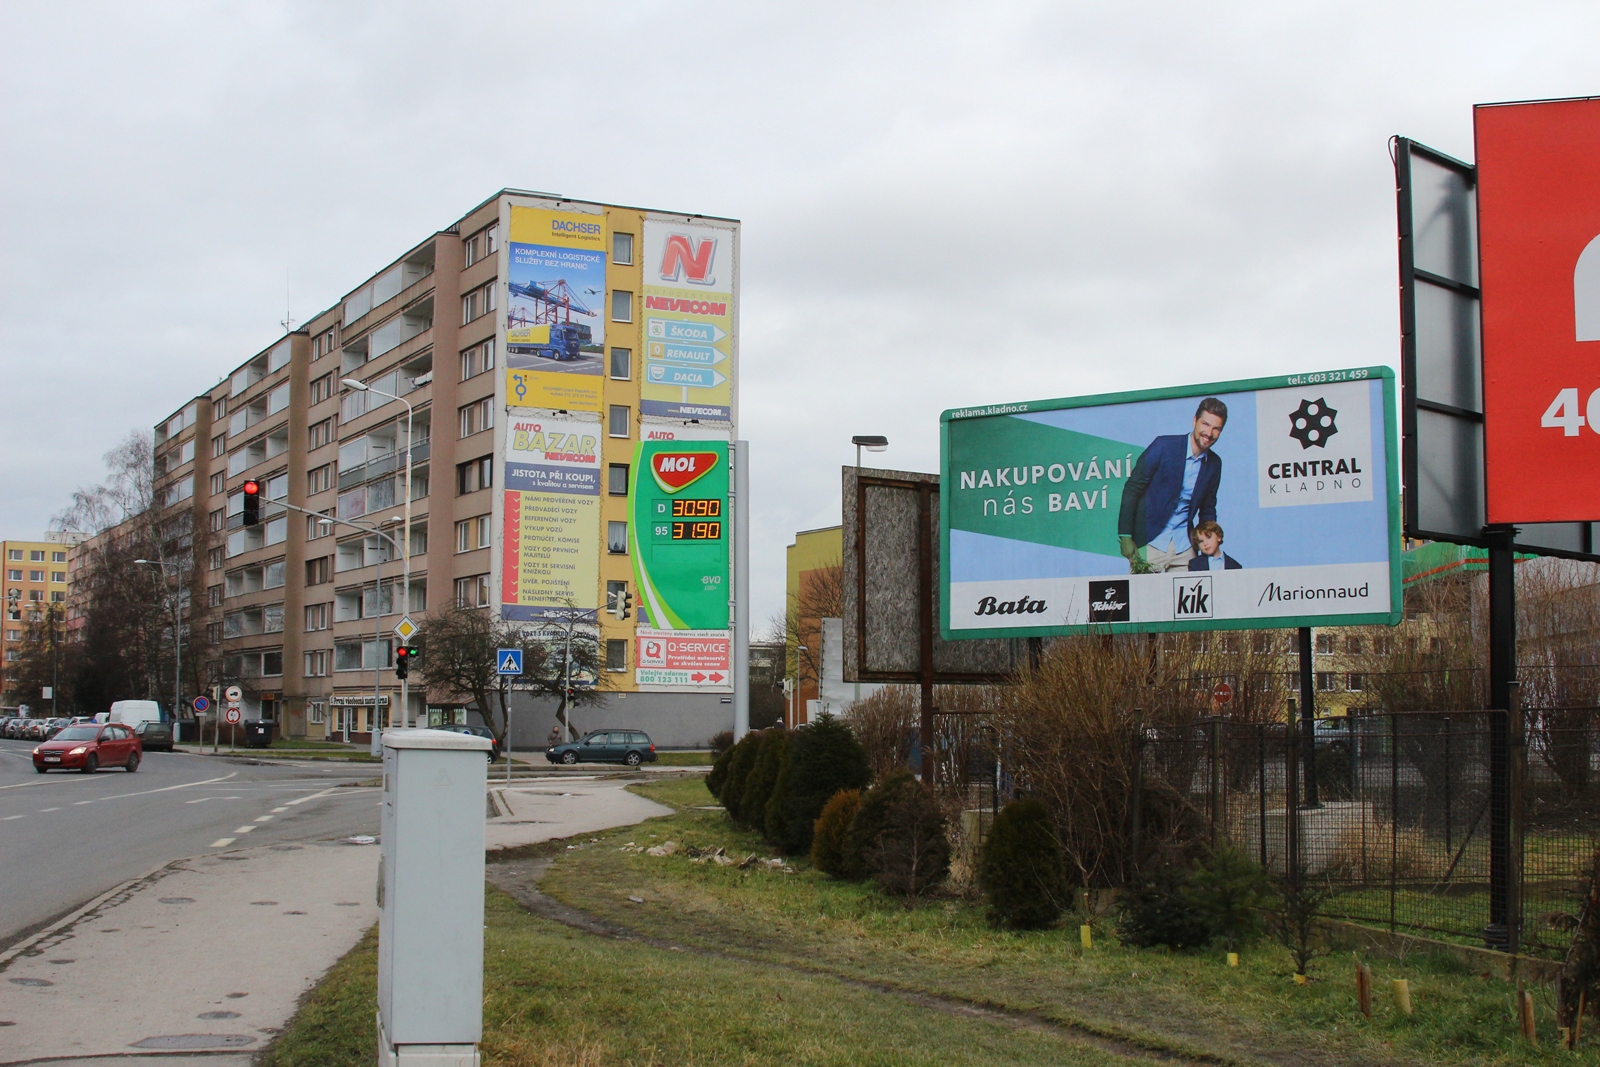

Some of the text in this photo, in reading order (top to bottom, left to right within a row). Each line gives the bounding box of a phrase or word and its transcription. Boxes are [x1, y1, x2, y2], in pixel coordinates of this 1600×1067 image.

[552, 220, 601, 234] DACHSER
[515, 248, 600, 263] KOMPLEXNÍ LOGISTICKÉ
[515, 256, 543, 265] SLUŽBY
[560, 262, 588, 270] HRANIC
[646, 295, 727, 316] NEVECOM
[670, 325, 707, 338] ŠKODA
[667, 349, 710, 360] RENAULT
[674, 372, 702, 382] DACIA
[1288, 370, 1368, 385] tel.: 603 321 459
[951, 403, 1028, 419] reklama.kladno.cz
[513, 422, 542, 432] AUTO
[513, 430, 596, 454] BAZAR
[648, 431, 674, 440] AUTO
[544, 452, 596, 463] NEVECOM
[660, 457, 696, 472] MOL
[960, 453, 1132, 490] NAKUPOVÁNÍ
[1268, 458, 1362, 479] CENTRAL
[512, 469, 596, 483] JISTOTA PŘI KOUPI,
[537, 479, 561, 488] kvalitou
[1269, 478, 1361, 493] KLADNO
[983, 484, 1109, 516] nás BAVÍ
[658, 504, 665, 512] D
[655, 526, 668, 536] 95
[1177, 579, 1209, 614] kik
[1258, 582, 1369, 607] Marionnaud
[974, 595, 1048, 616] Baťa
[1091, 601, 1127, 611] Tchibo
